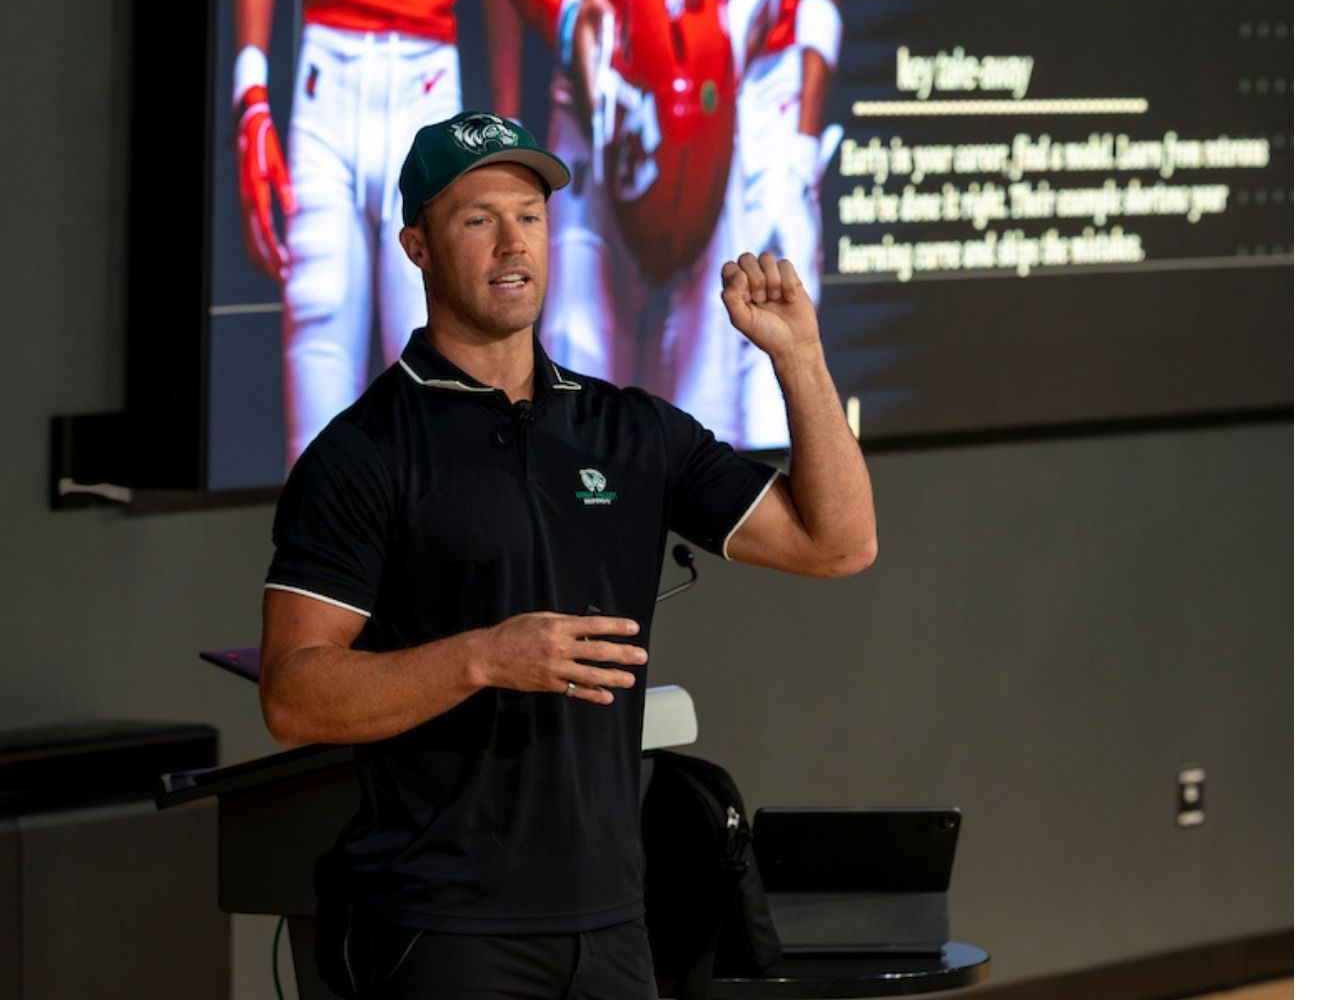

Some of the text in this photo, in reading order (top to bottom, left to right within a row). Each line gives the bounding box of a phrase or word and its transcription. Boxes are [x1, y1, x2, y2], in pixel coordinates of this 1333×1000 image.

[890, 136, 912, 174] in
[911, 144, 953, 184] your
[1160, 130, 1202, 179] from
[900, 184, 941, 222] done
[1187, 184, 1230, 224] your
[838, 234, 913, 282] learning
[962, 230, 997, 269] and
[1039, 228, 1069, 266] the
